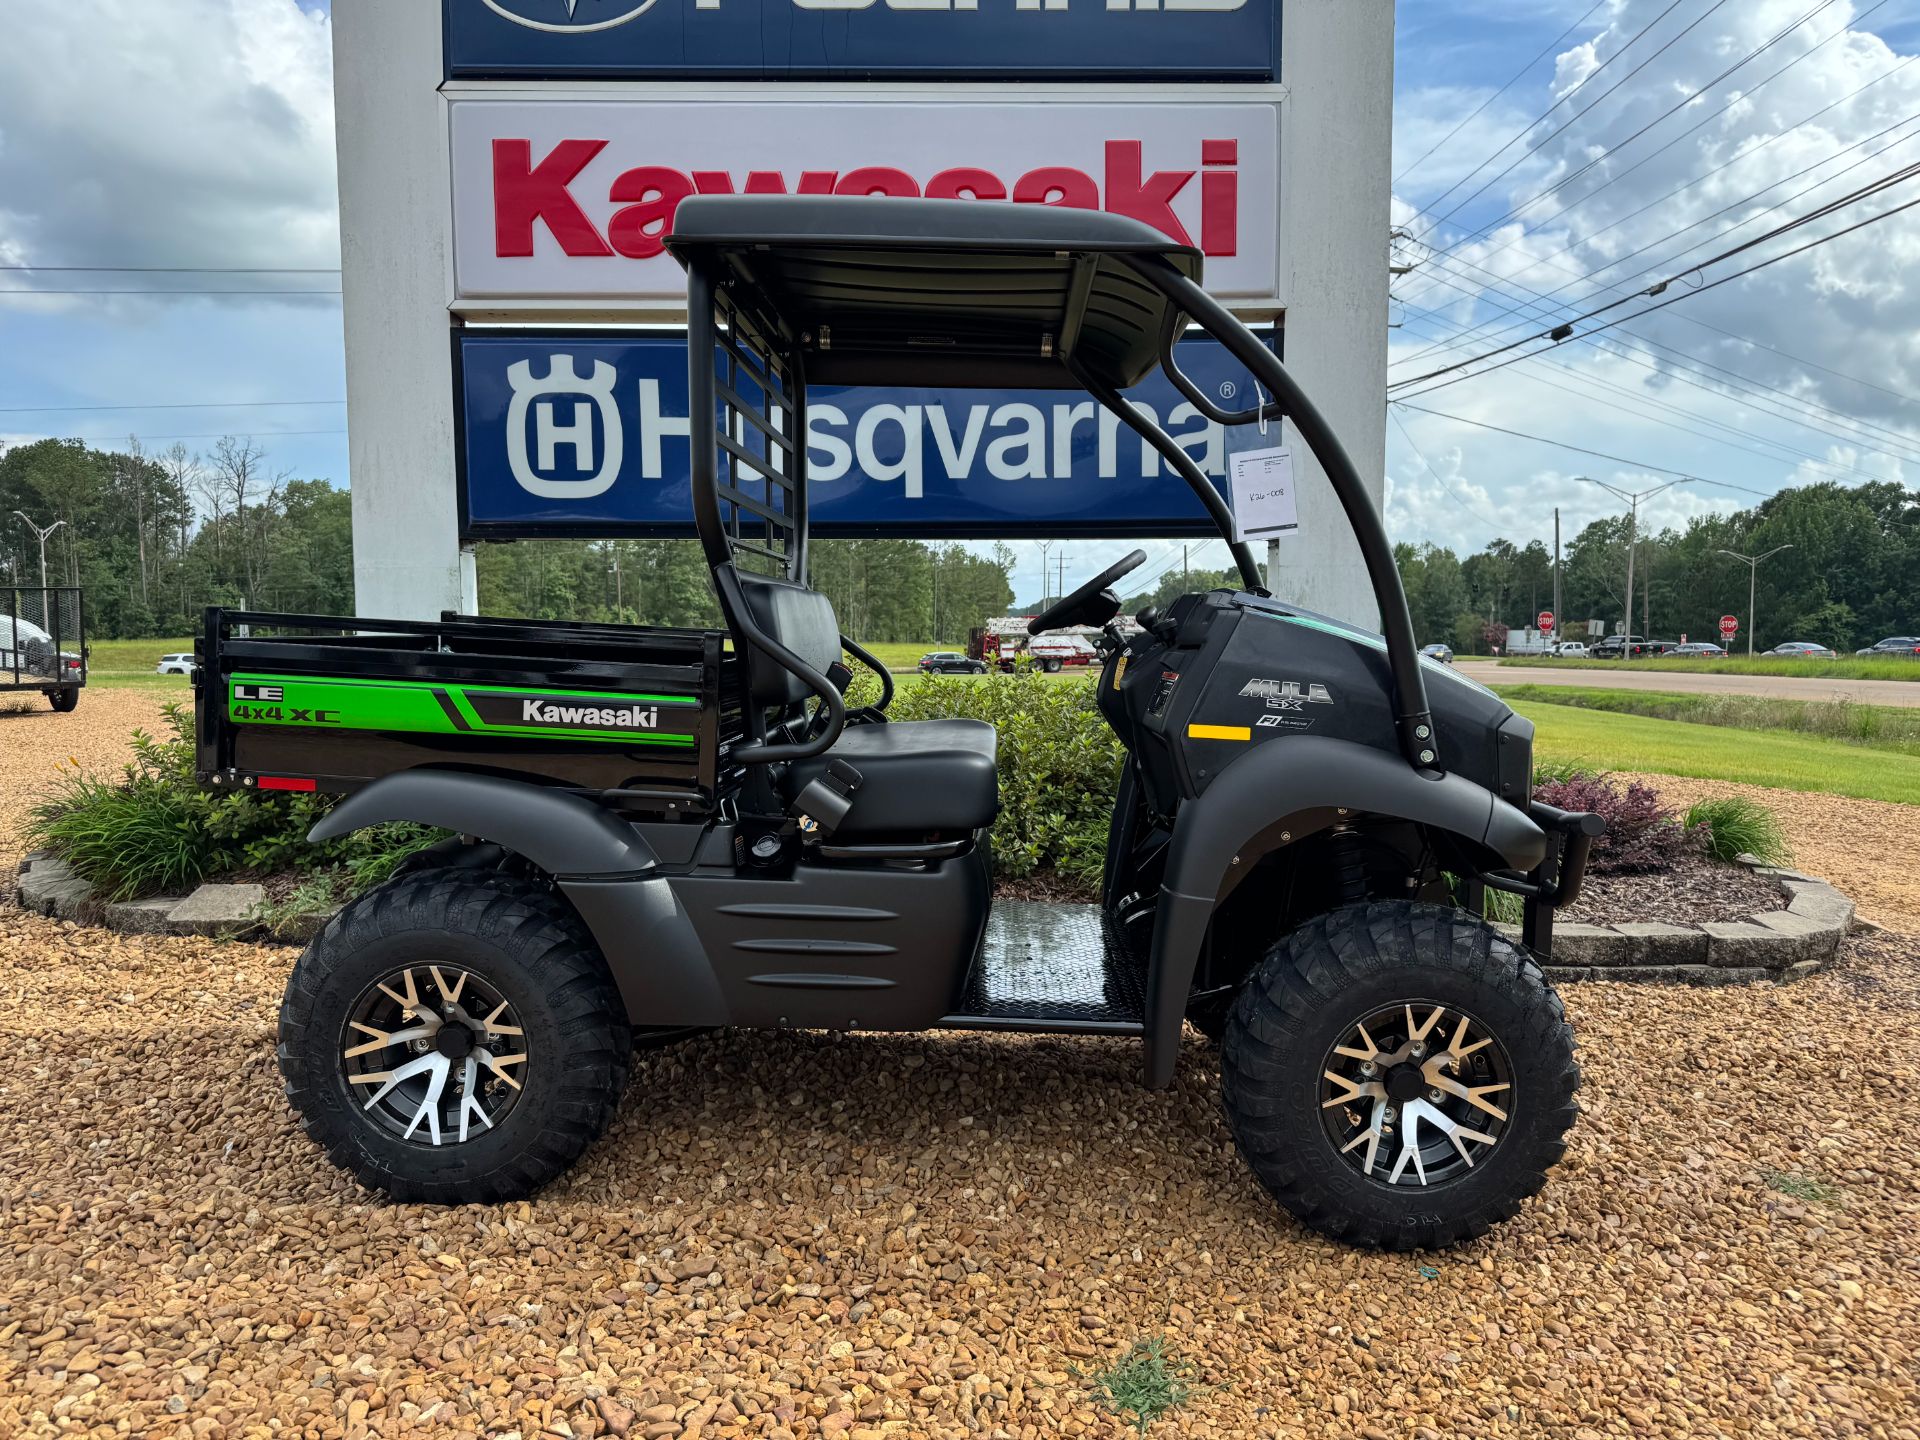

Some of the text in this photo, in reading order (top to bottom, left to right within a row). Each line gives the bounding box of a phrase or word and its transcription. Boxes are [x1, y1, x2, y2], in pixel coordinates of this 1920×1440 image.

[492, 138, 1238, 258] Kaki
[1721, 620, 1736, 628] STOP
[234, 685, 283, 701] LE
[1238, 678, 1334, 704] MULE
[522, 699, 658, 728] Kawasaki
[1266, 698, 1303, 711] SX
